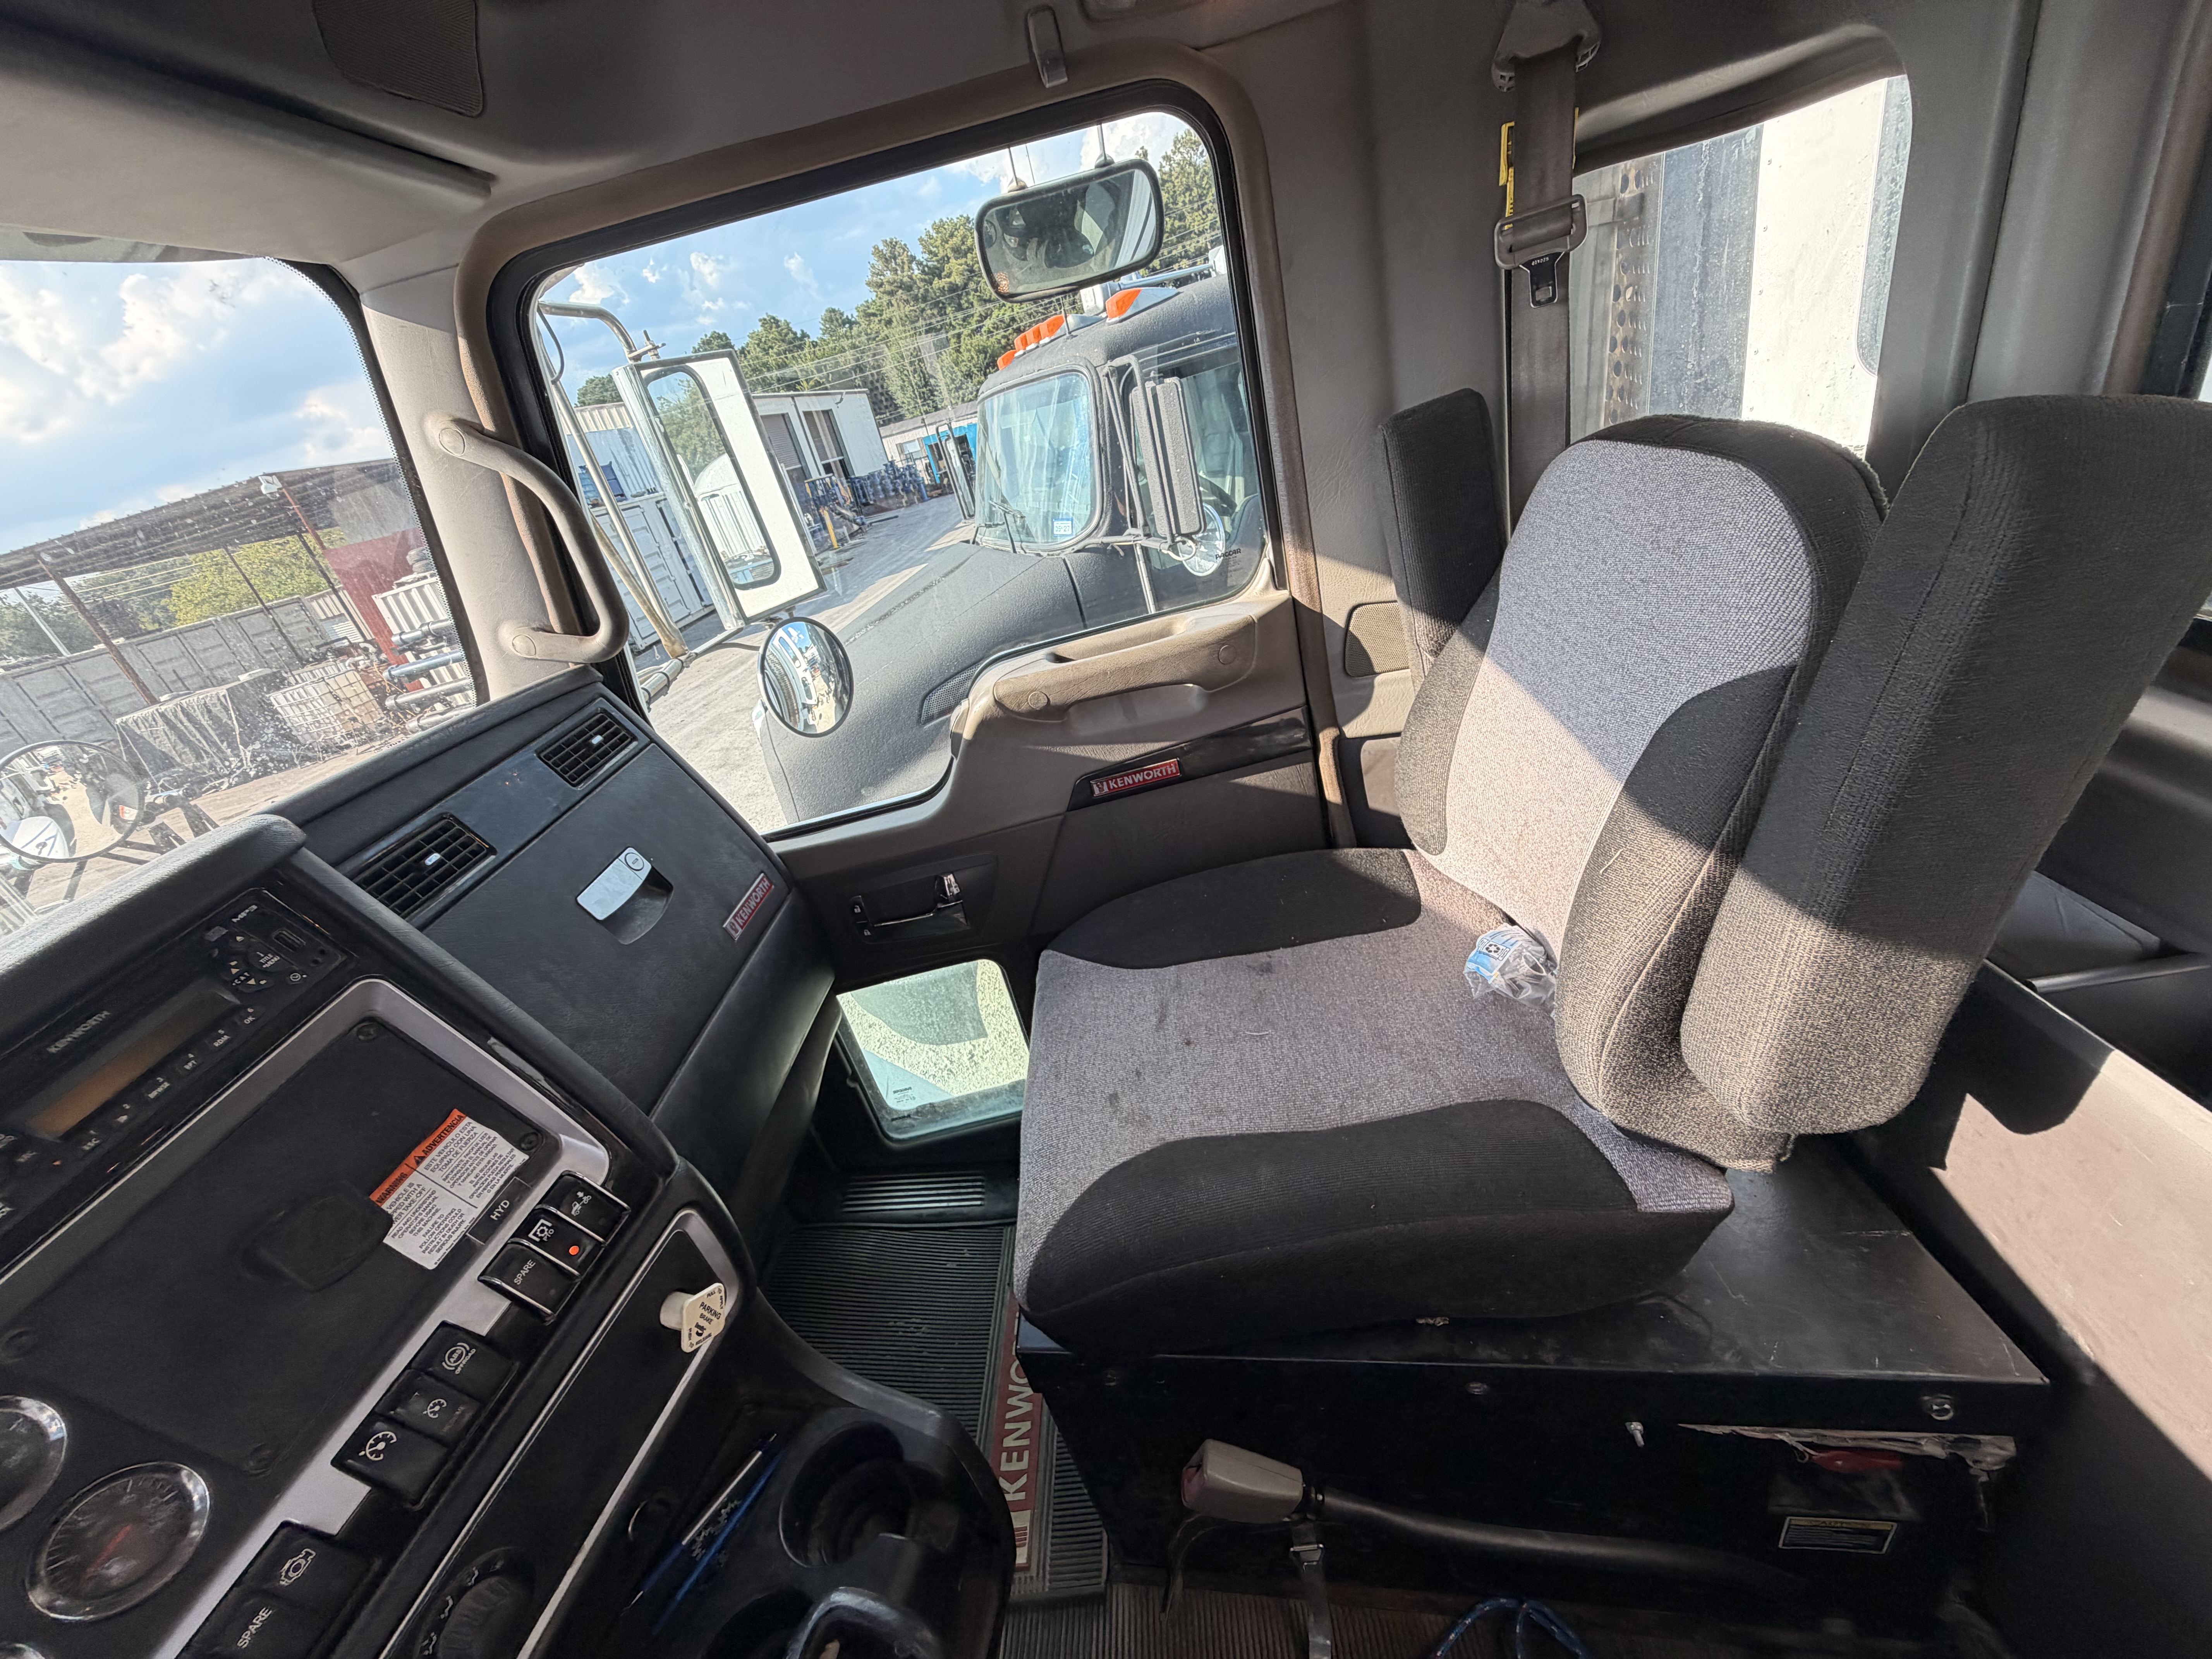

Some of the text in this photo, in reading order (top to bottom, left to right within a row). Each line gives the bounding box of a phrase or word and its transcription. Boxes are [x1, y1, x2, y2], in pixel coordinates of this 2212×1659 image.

[1214, 548, 1242, 560] PACCAR
[1109, 763, 1177, 789] KENWORTH
[734, 878, 771, 926] KENWORTH
[259, 952, 273, 965] TITLE
[46, 1007, 111, 1056] KENWORTH
[243, 1014, 256, 1025] OK
[213, 1032, 231, 1048] RDM
[421, 1113, 464, 1155] ADVERTENCIA
[423, 1157, 438, 1171] ESTE
[459, 1120, 472, 1133] ESTA
[453, 1135, 466, 1148] CON
[464, 1125, 477, 1137] UNA
[463, 1146, 476, 1158] FAVOR
[478, 1132, 488, 1142] LEER
[438, 1130, 478, 1173] TOMA DE FUERZA
[449, 1159, 470, 1181] CONSULTAR
[472, 1140, 487, 1155] MANUAL
[468, 1155, 480, 1168] ANTES
[483, 1136, 497, 1151] OPERAR
[478, 1159, 492, 1173] SEGUIR
[490, 1152, 498, 1160] LAS
[498, 1147, 515, 1166] RESULTAR
[460, 1166, 477, 1183] MANEJAR
[476, 1157, 485, 1166] ESTA
[472, 1159, 499, 1188] INSTRUCCIONES
[481, 1176, 496, 1192] HERIDAS
[494, 1153, 516, 1177] PERSONALES
[375, 1172, 407, 1204] WARNING
[386, 1187, 409, 1211] VEHICLE
[402, 1187, 418, 1202] WITH
[402, 1186, 427, 1212] TAKE-OFF
[391, 1189, 437, 1238] READ AND UNDERSTAND
[421, 1195, 438, 1212] MANUAL
[489, 1197, 510, 1221] HYD
[408, 1204, 437, 1235] BEFORE USING
[412, 1226, 423, 1237] THIS
[419, 1207, 456, 1249] FOLLOW OPERATING
[421, 1208, 462, 1254] INSTRUCTIONS COULD
[422, 1220, 439, 1238] FAILURE
[427, 1238, 443, 1254] RESULT
[445, 1219, 459, 1233] DEATH
[434, 1234, 453, 1253] SERIOUS
[543, 1227, 555, 1242] PTO
[513, 1258, 536, 1286] SPARE
[698, 1301, 722, 1320] PARKING
[699, 1312, 713, 1324] BRAKE
[448, 1348, 462, 1364] ABS
[236, 1606, 273, 1649] SPARE
